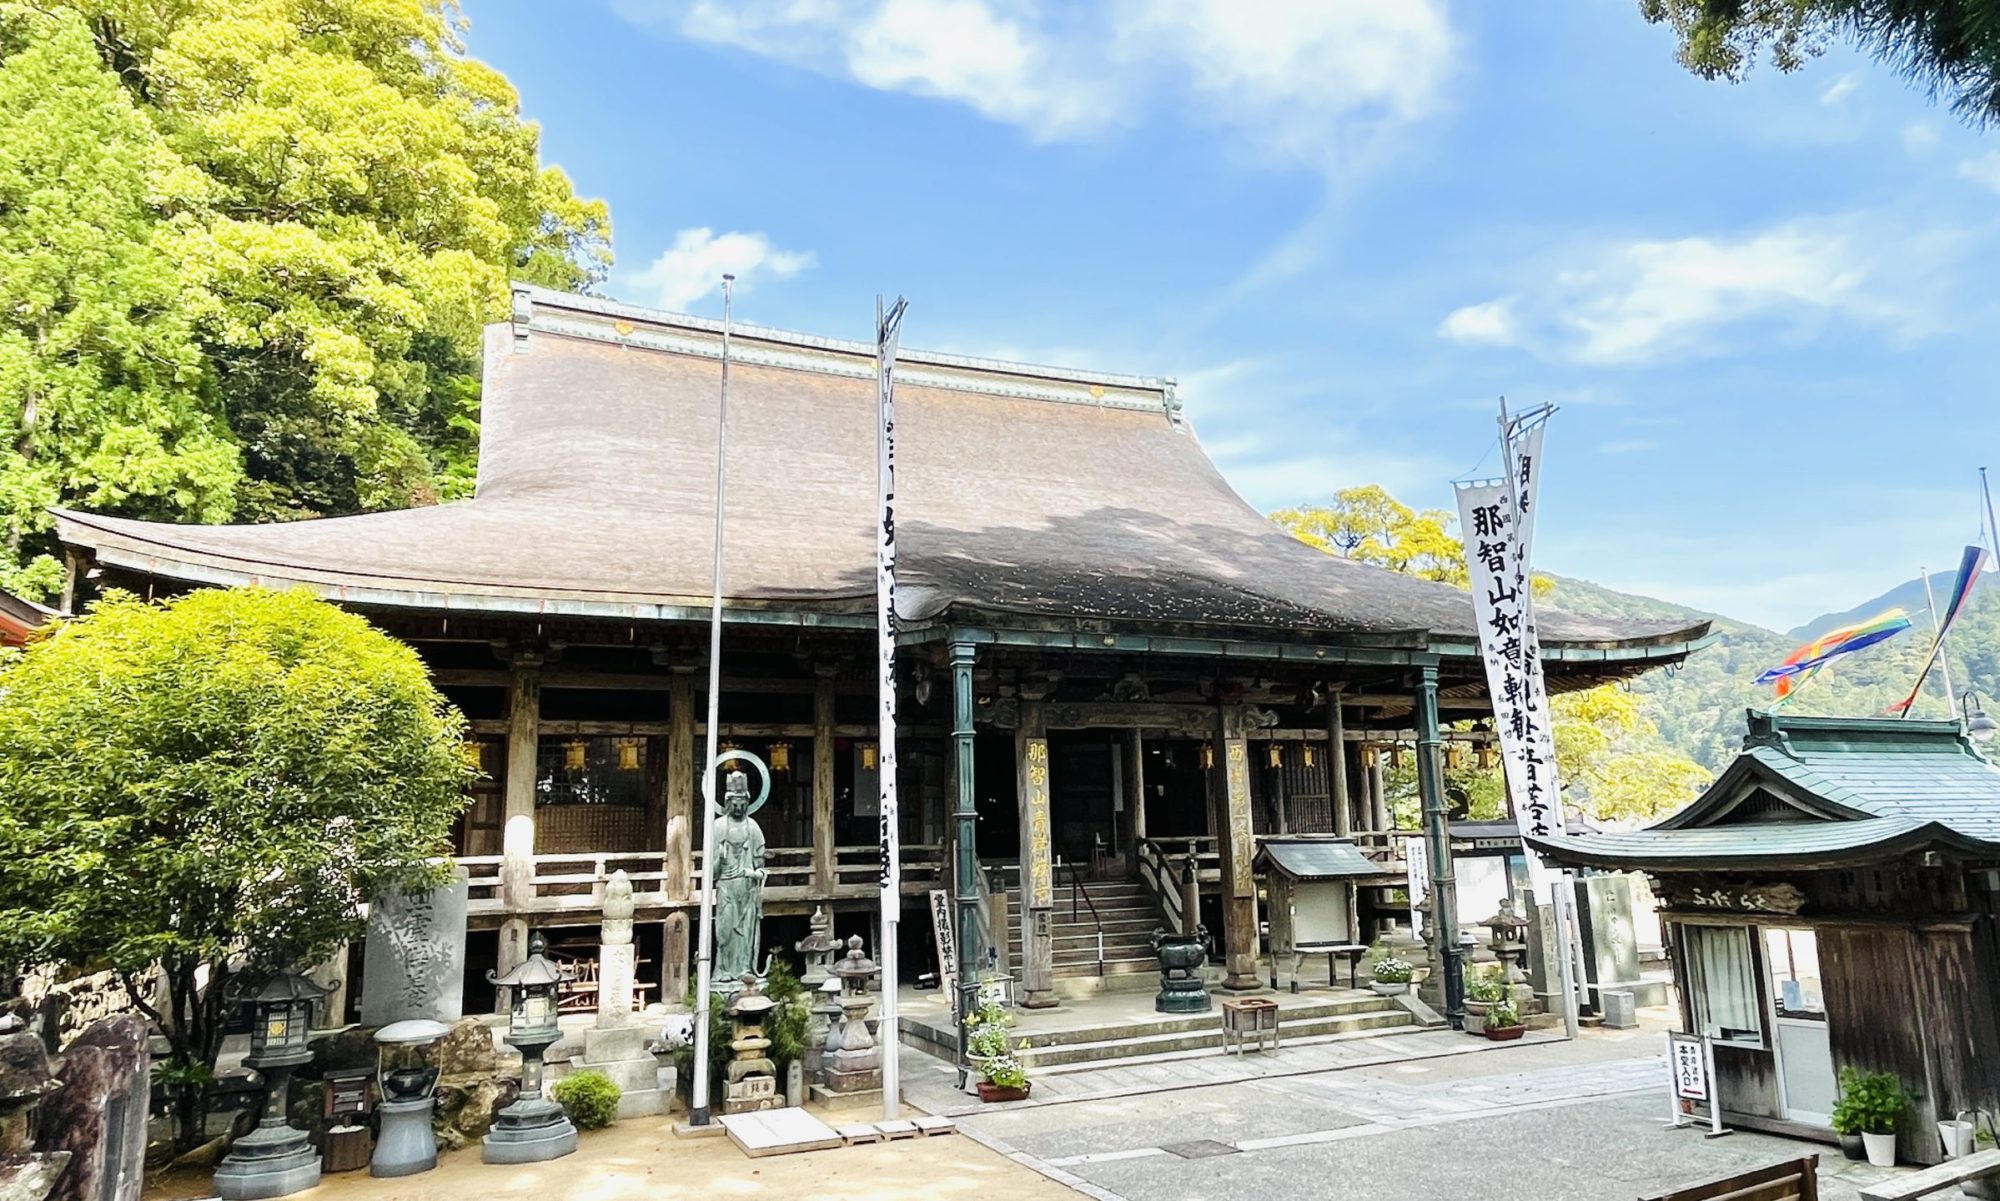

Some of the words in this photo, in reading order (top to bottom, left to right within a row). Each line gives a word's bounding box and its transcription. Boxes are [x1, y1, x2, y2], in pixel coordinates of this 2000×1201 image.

[1028, 743, 1050, 903] 那智山青岸渡寺
[934, 893, 956, 975] 堂内撮影禁止
[1679, 1045, 1691, 1086] 本堂入口
